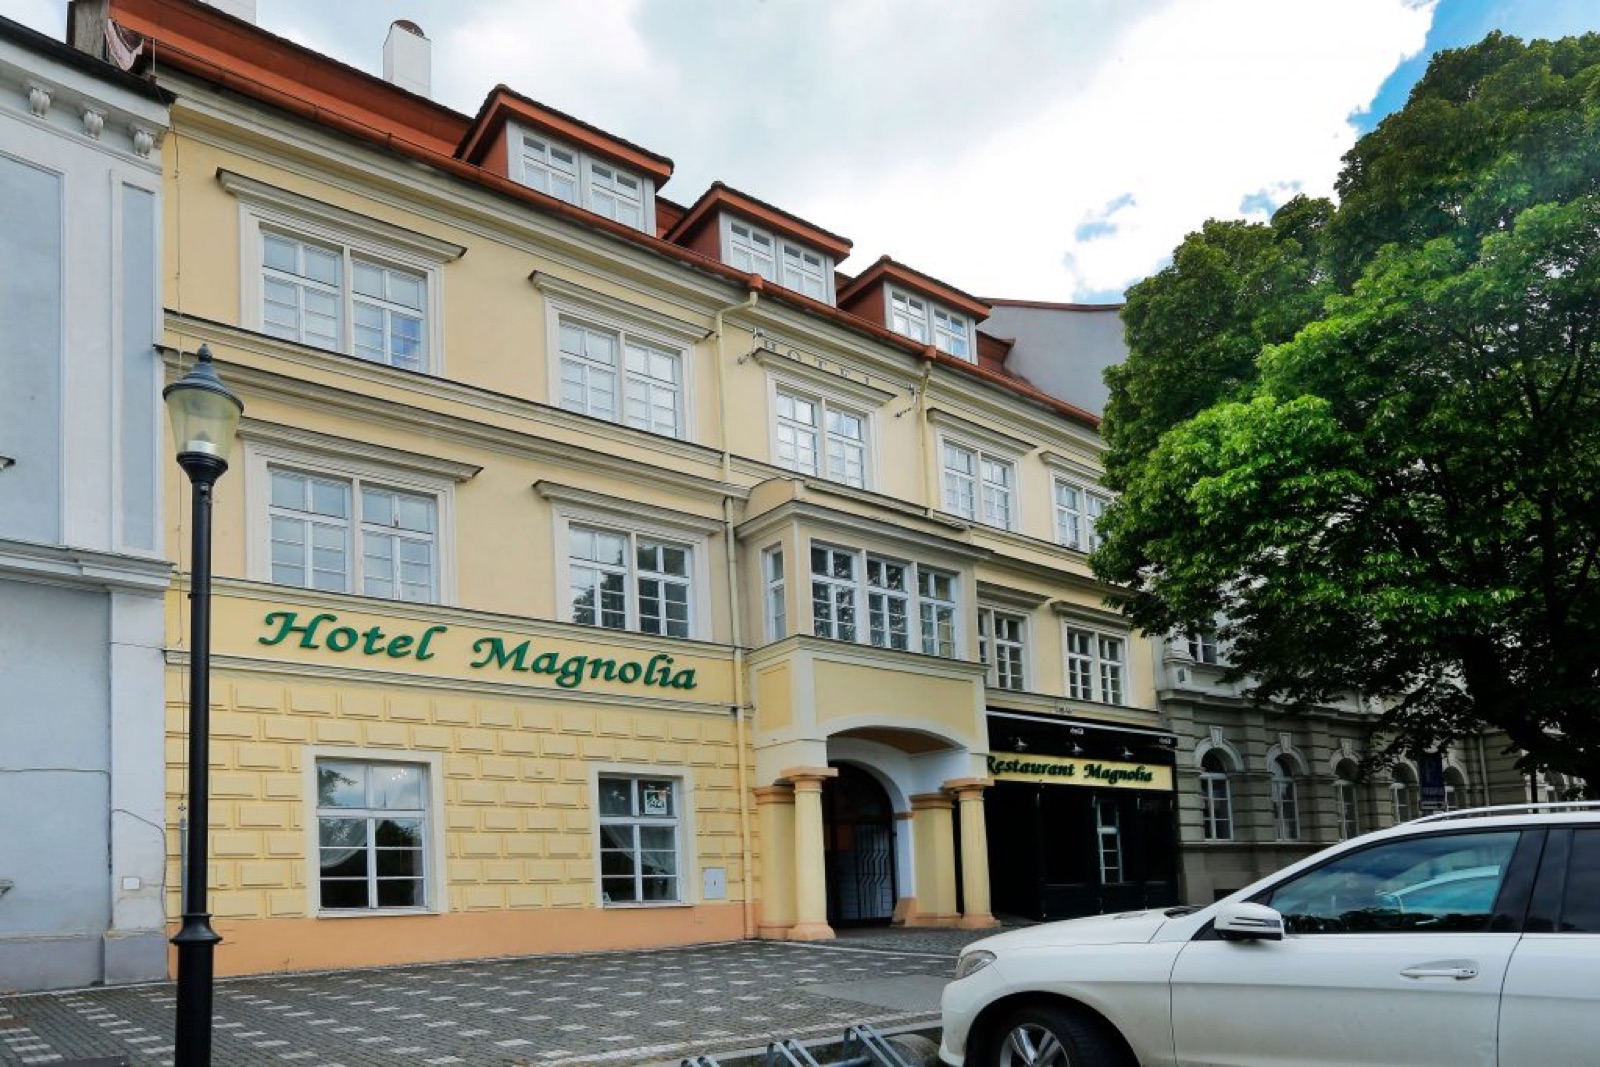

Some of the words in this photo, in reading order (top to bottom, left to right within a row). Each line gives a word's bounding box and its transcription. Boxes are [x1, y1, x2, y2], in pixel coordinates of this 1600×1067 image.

[258, 611, 448, 661] Hotel
[470, 637, 697, 689] Magnolia
[986, 756, 1075, 777] Restaurant
[1084, 764, 1153, 784] Magnolia
